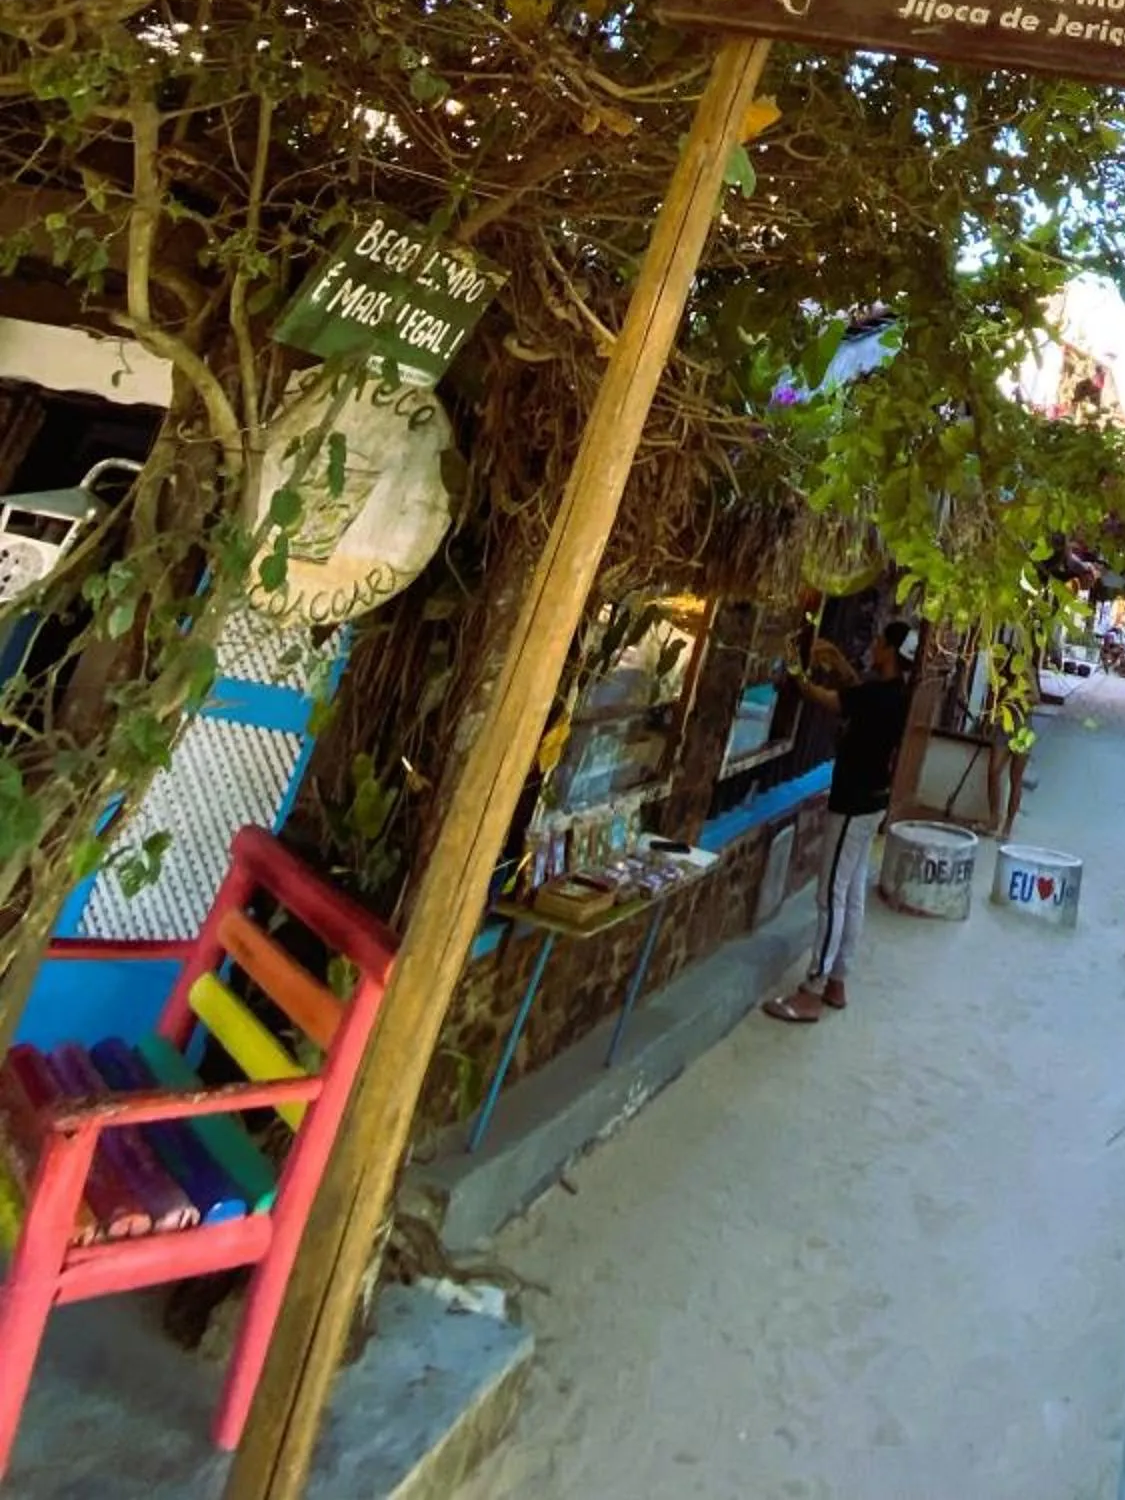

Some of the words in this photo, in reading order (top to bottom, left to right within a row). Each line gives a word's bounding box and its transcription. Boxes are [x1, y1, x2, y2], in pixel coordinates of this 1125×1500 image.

[1000, 6, 1040, 31] de
[355, 219, 422, 272] BECO
[326, 278, 392, 326] MAIS
[1009, 869, 1035, 902] EU
